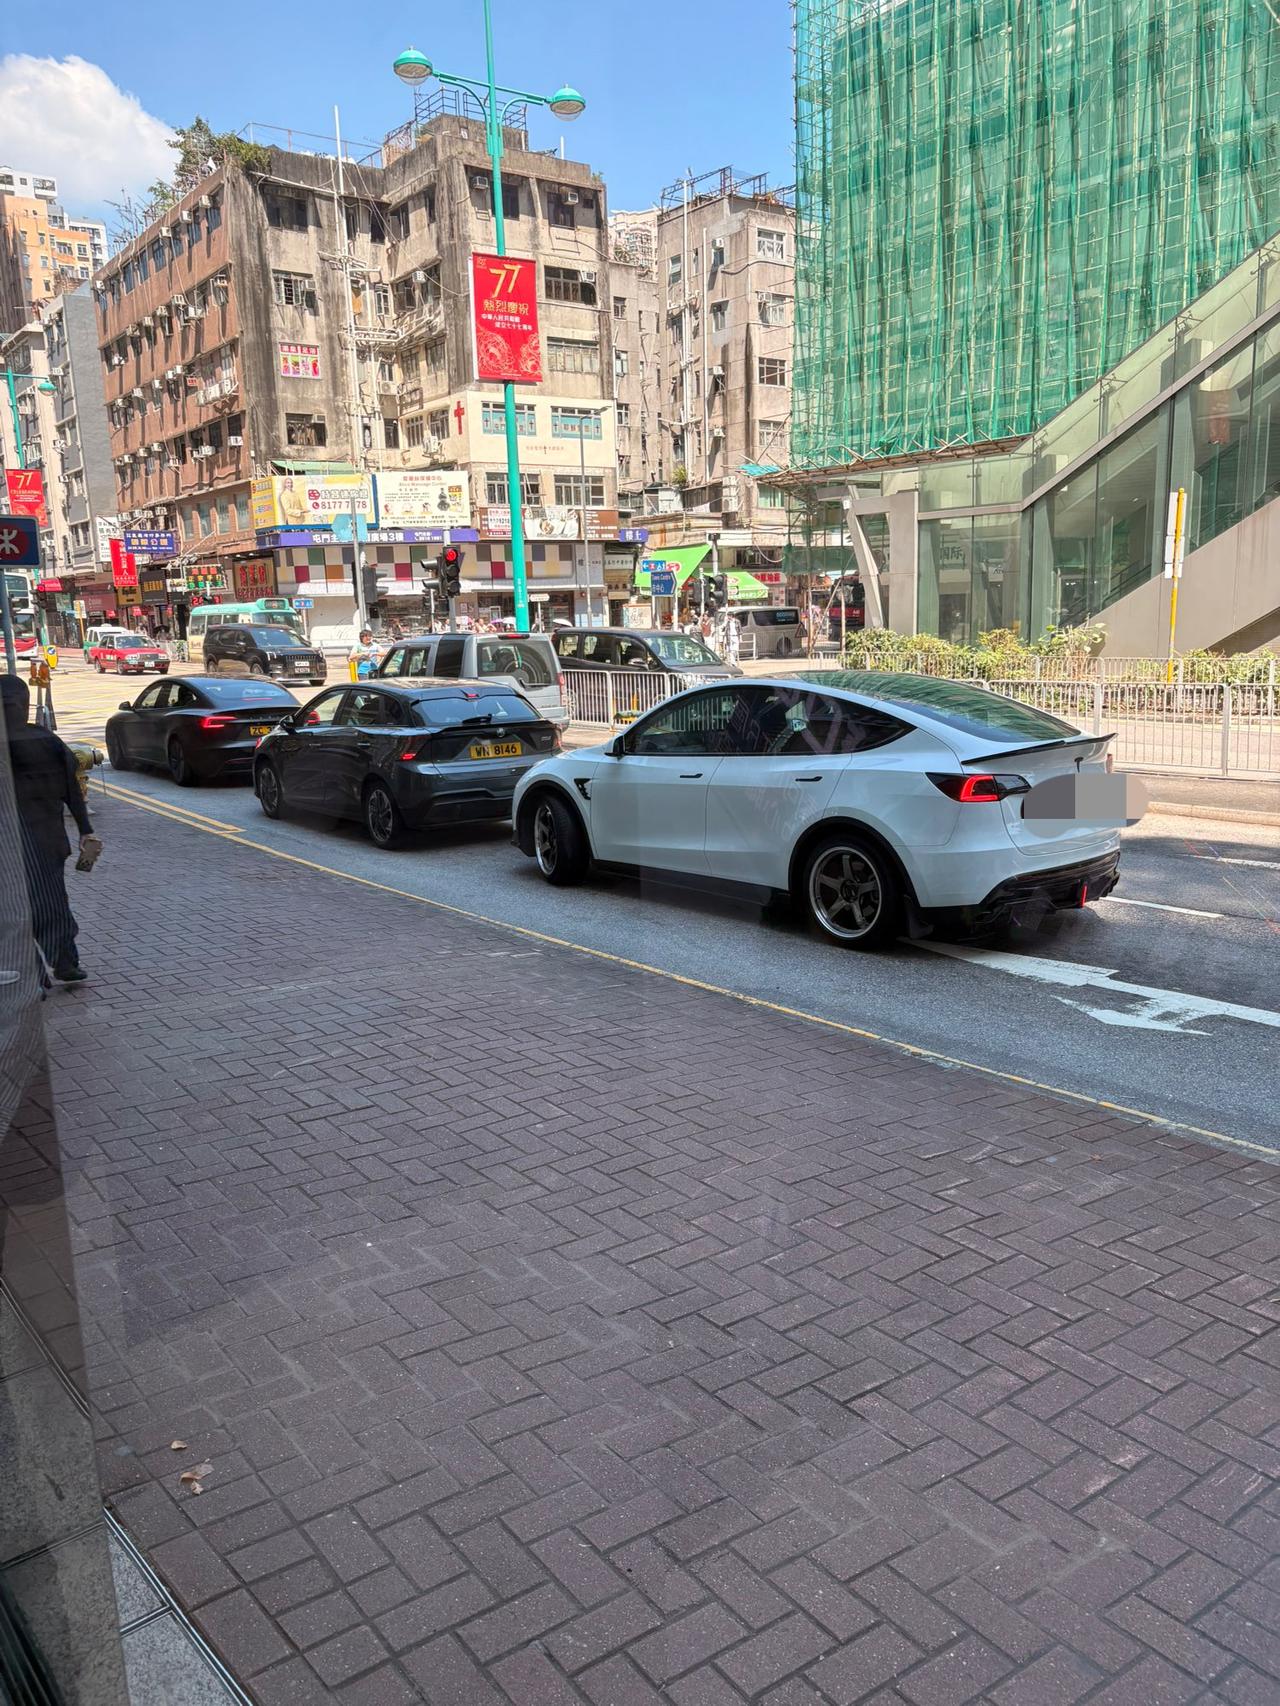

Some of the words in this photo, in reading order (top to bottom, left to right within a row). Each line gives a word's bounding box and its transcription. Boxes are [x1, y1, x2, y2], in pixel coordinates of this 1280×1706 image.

[489, 264, 523, 298] 77
[483, 299, 529, 315] 熱烈慶祝
[16, 472, 33, 489] 77
[320, 501, 342, 510] 8177
[345, 500, 367, 510] 778
[475, 746, 489, 757] WN
[494, 743, 517, 755] 8146
